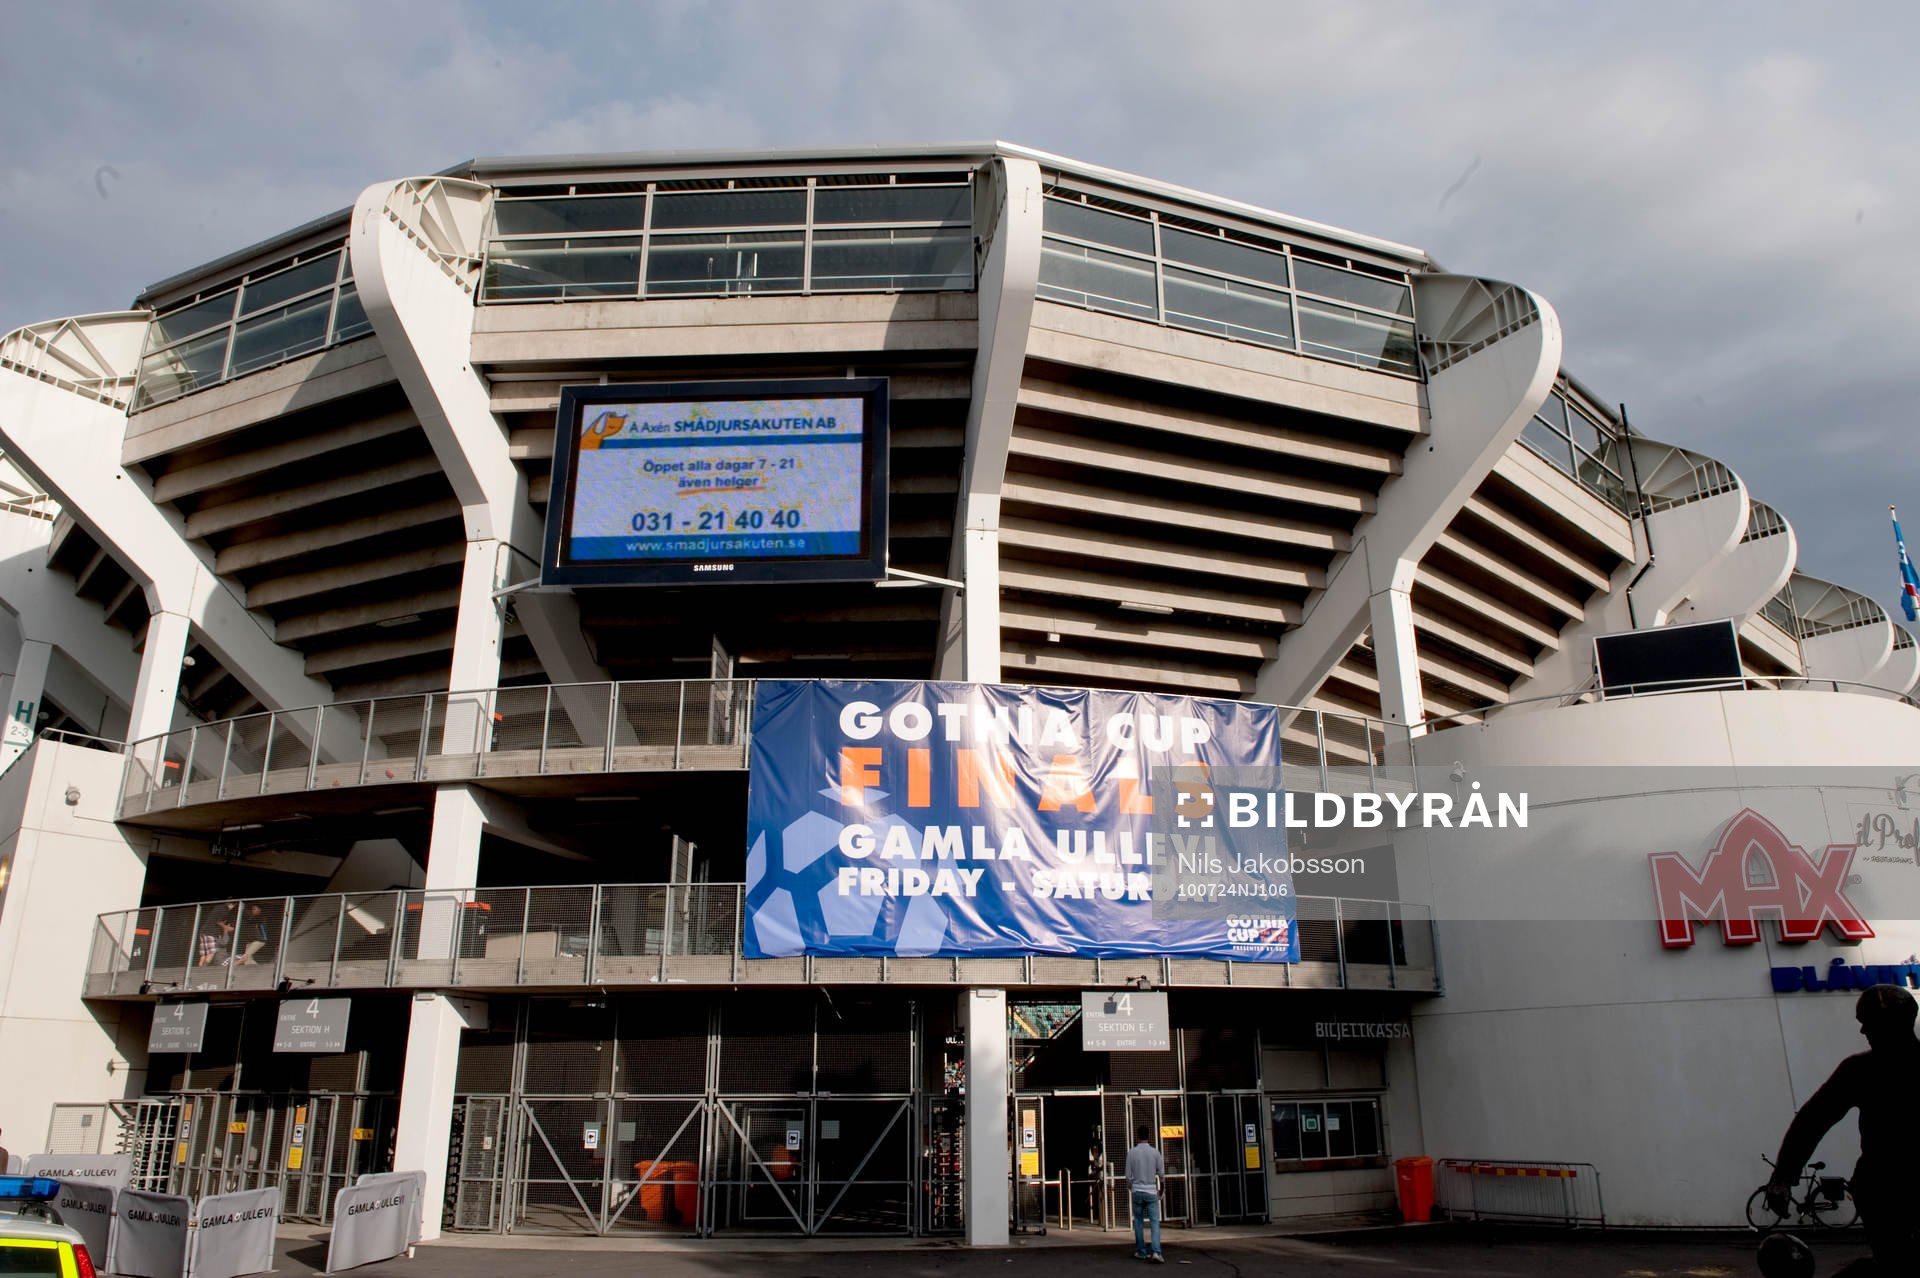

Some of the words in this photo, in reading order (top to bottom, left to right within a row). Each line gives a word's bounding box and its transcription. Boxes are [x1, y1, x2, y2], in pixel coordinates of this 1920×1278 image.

[674, 417, 813, 434] SMÅDJURSAKUTEN
[816, 417, 837, 429] AB
[643, 460, 684, 474] Öppet
[687, 461, 712, 471] alla
[715, 460, 755, 473] dagar
[758, 459, 767, 470] 7
[779, 458, 795, 470] 21
[678, 477, 711, 488] även
[715, 477, 758, 489] helger
[631, 512, 673, 531] 031
[698, 511, 725, 530] 21
[735, 510, 764, 529] 40
[771, 509, 800, 528] 40
[693, 564, 734, 572] SAMSUNG
[15, 700, 35, 723] H
[10, 725, 29, 737] 2-3
[839, 701, 1082, 750] GOTHIA
[1106, 712, 1212, 754] CUP
[841, 747, 1216, 819] FINALS
[838, 823, 1034, 862] GAMLA
[1056, 829, 1218, 868] ULLEVI
[838, 867, 984, 897] FRIDAY
[1032, 870, 1219, 903] SATURDAY
[1647, 807, 1876, 949] MAX
[1226, 914, 1289, 929] GOTHIA
[1227, 928, 1260, 942] CUP
[173, 1000, 185, 1021] 4
[305, 998, 320, 1020] 4
[1117, 993, 1134, 1017] 4
[291, 1025, 322, 1034] SEKTION
[324, 1025, 331, 1034] H
[1098, 1023, 1136, 1032] SEKTION
[1315, 1022, 1411, 1040] BILJETTKASSA
[38, 1168, 74, 1178] GAMLA
[83, 1168, 117, 1178] ULLEVI
[60, 1198, 84, 1211] GAMLA
[348, 1201, 375, 1216] GAMLA
[380, 1194, 405, 1209] ULLEVI
[127, 1209, 154, 1223] GAMLA
[158, 1212, 182, 1228] ULLEVI
[201, 1213, 234, 1229] GAMLA
[241, 1207, 274, 1222] ULLEVI
